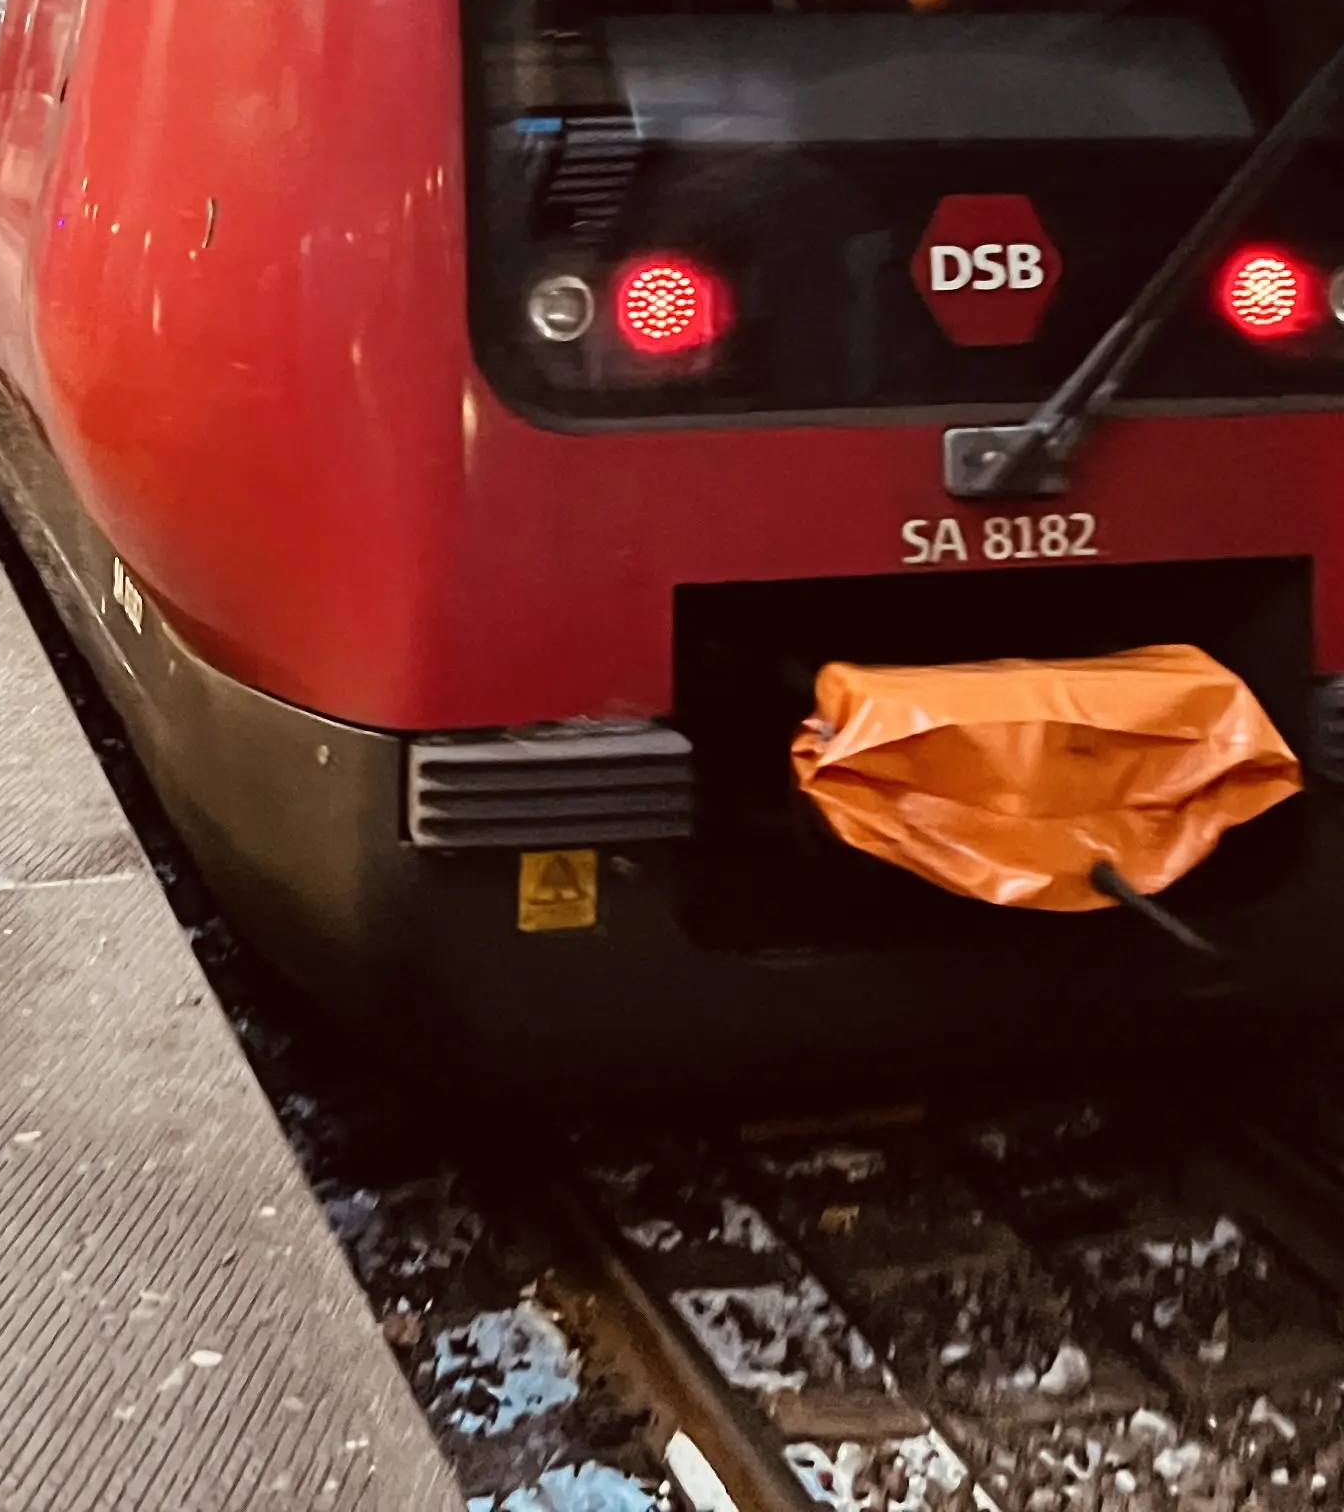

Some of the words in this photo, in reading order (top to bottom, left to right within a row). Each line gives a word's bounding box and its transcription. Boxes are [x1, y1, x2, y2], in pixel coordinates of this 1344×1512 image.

[930, 244, 1045, 291] DSB
[901, 518, 968, 564] SA
[982, 512, 1099, 561] 8182
